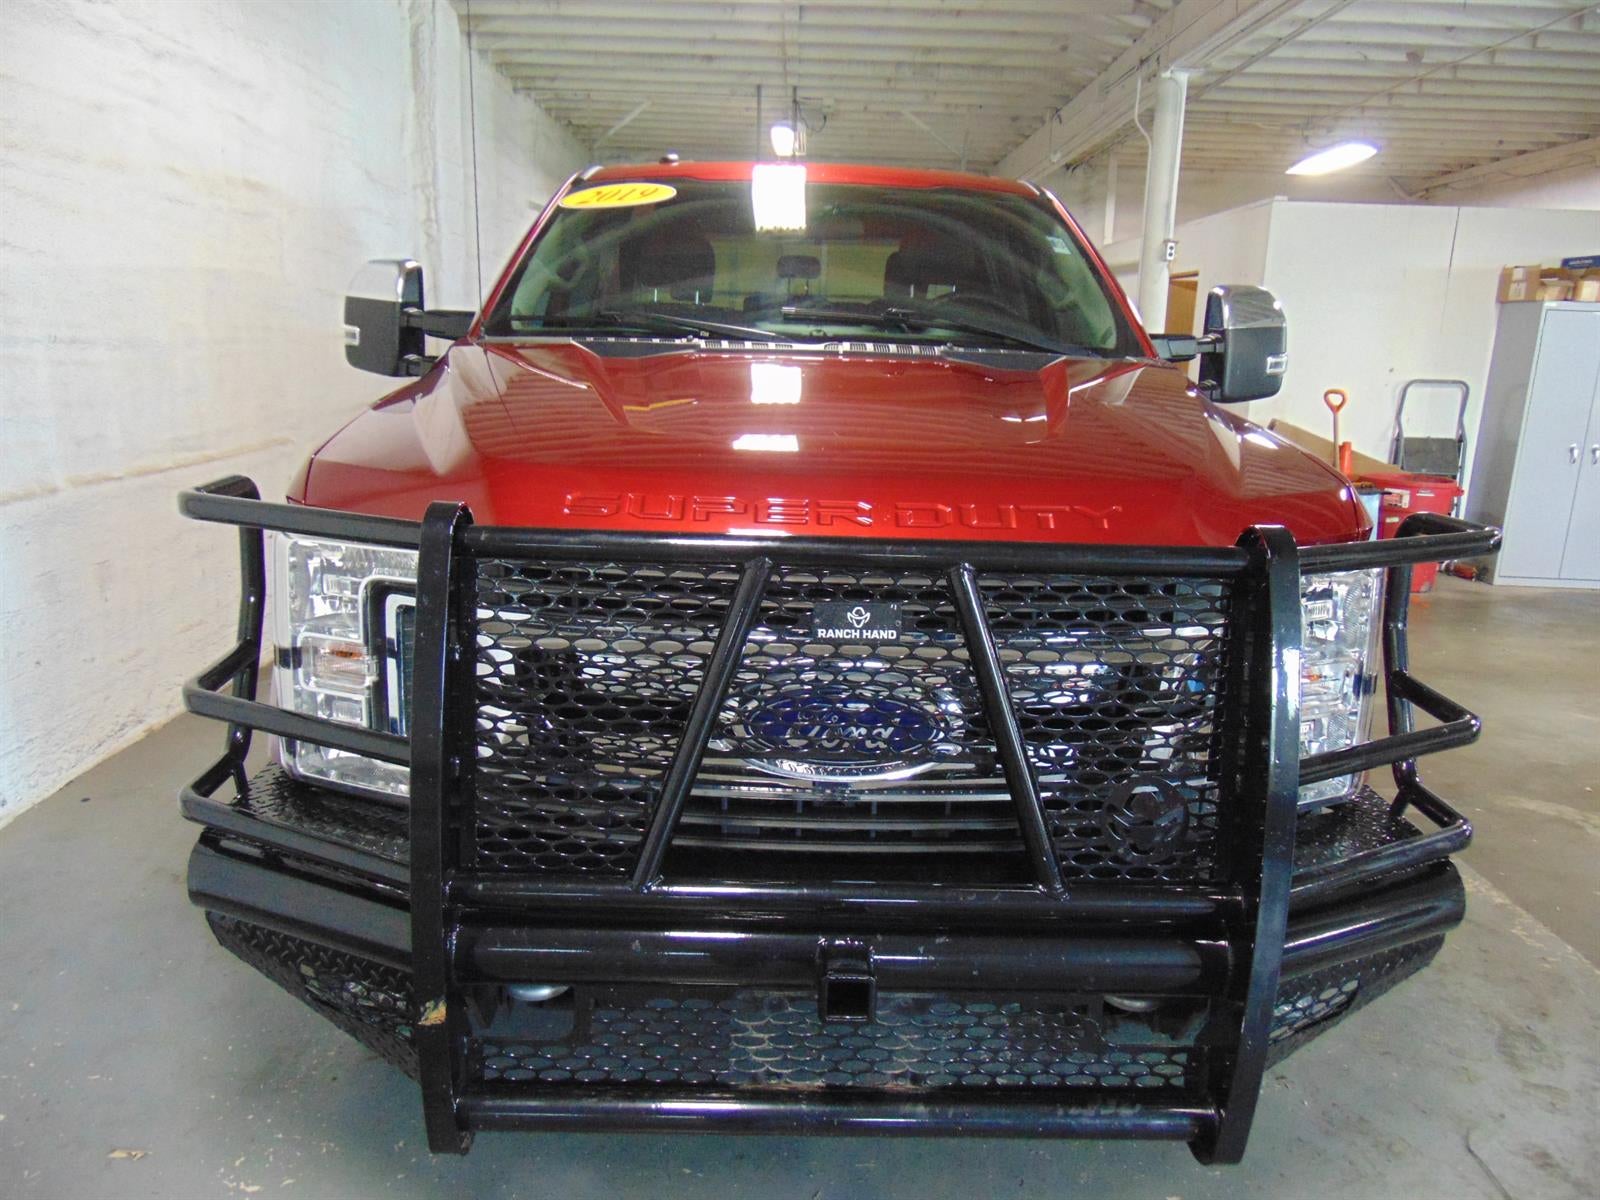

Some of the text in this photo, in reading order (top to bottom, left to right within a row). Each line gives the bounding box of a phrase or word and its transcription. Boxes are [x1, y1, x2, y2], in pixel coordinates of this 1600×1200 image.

[563, 492, 1124, 530] SUPER DUTY
[817, 628, 897, 640] RANCH HAND
